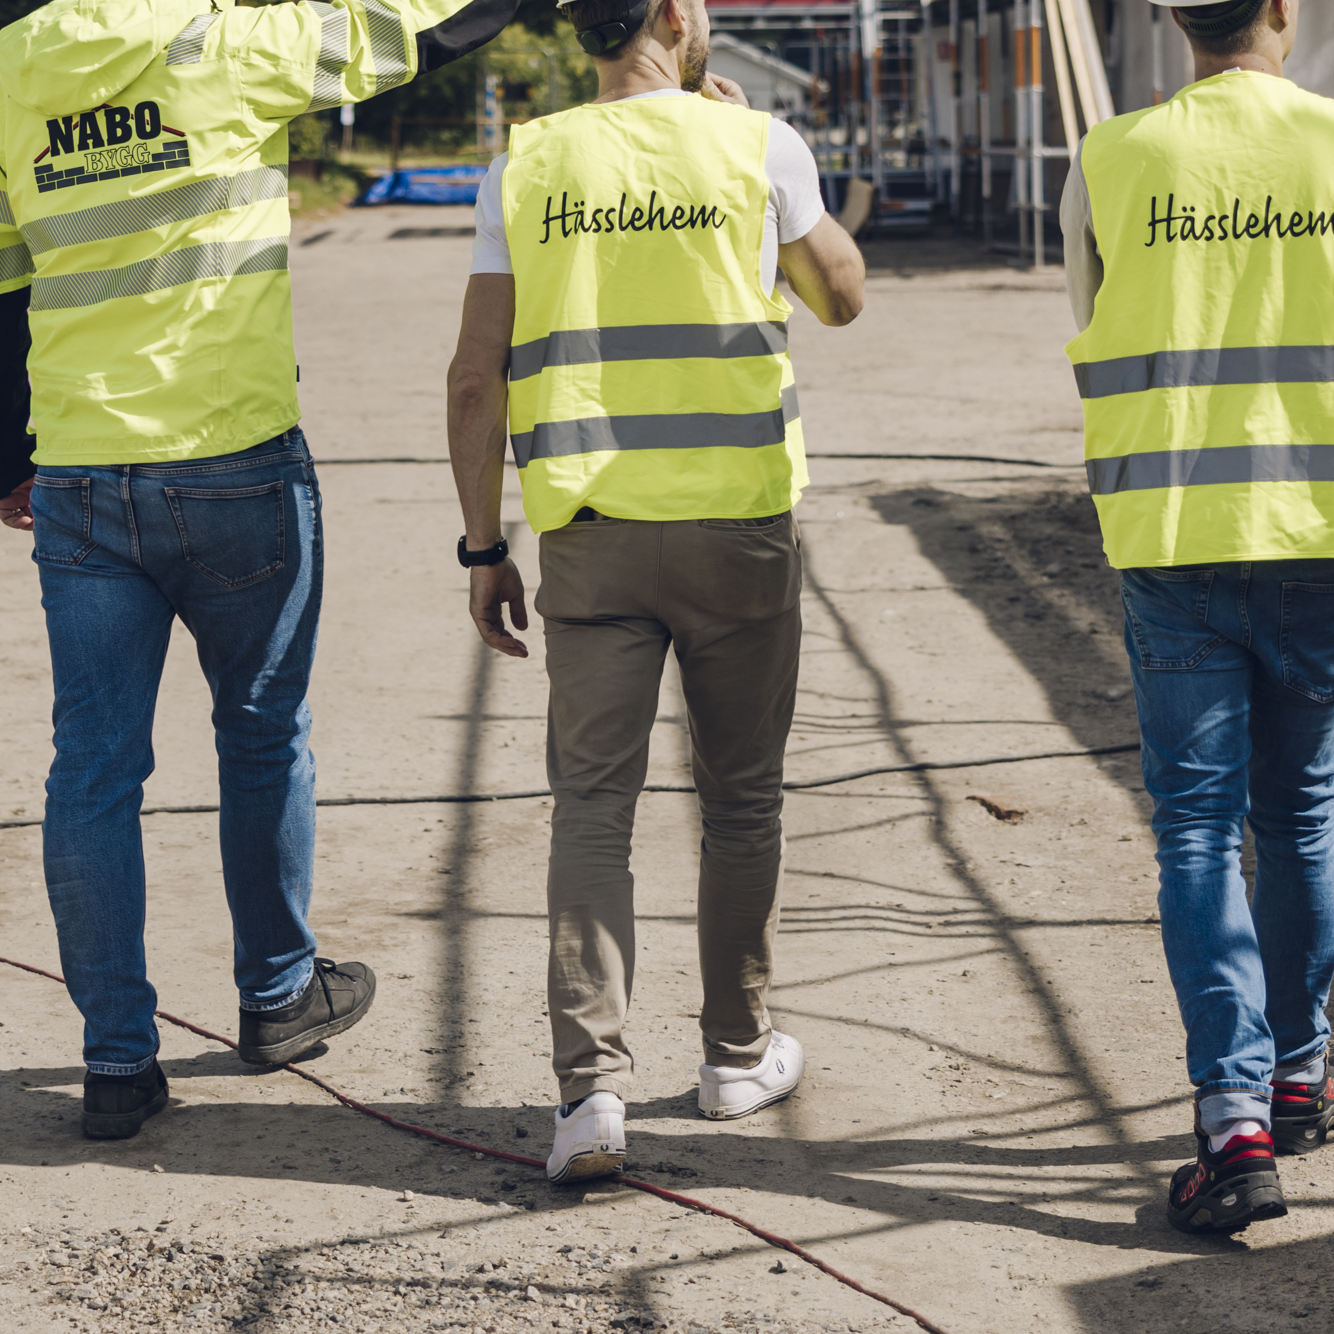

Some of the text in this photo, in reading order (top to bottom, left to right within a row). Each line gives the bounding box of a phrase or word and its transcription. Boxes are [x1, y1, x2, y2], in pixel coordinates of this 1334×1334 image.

[46, 101, 162, 157] NABO
[84, 143, 150, 173] BYGG
[539, 190, 727, 244] Hässlehem
